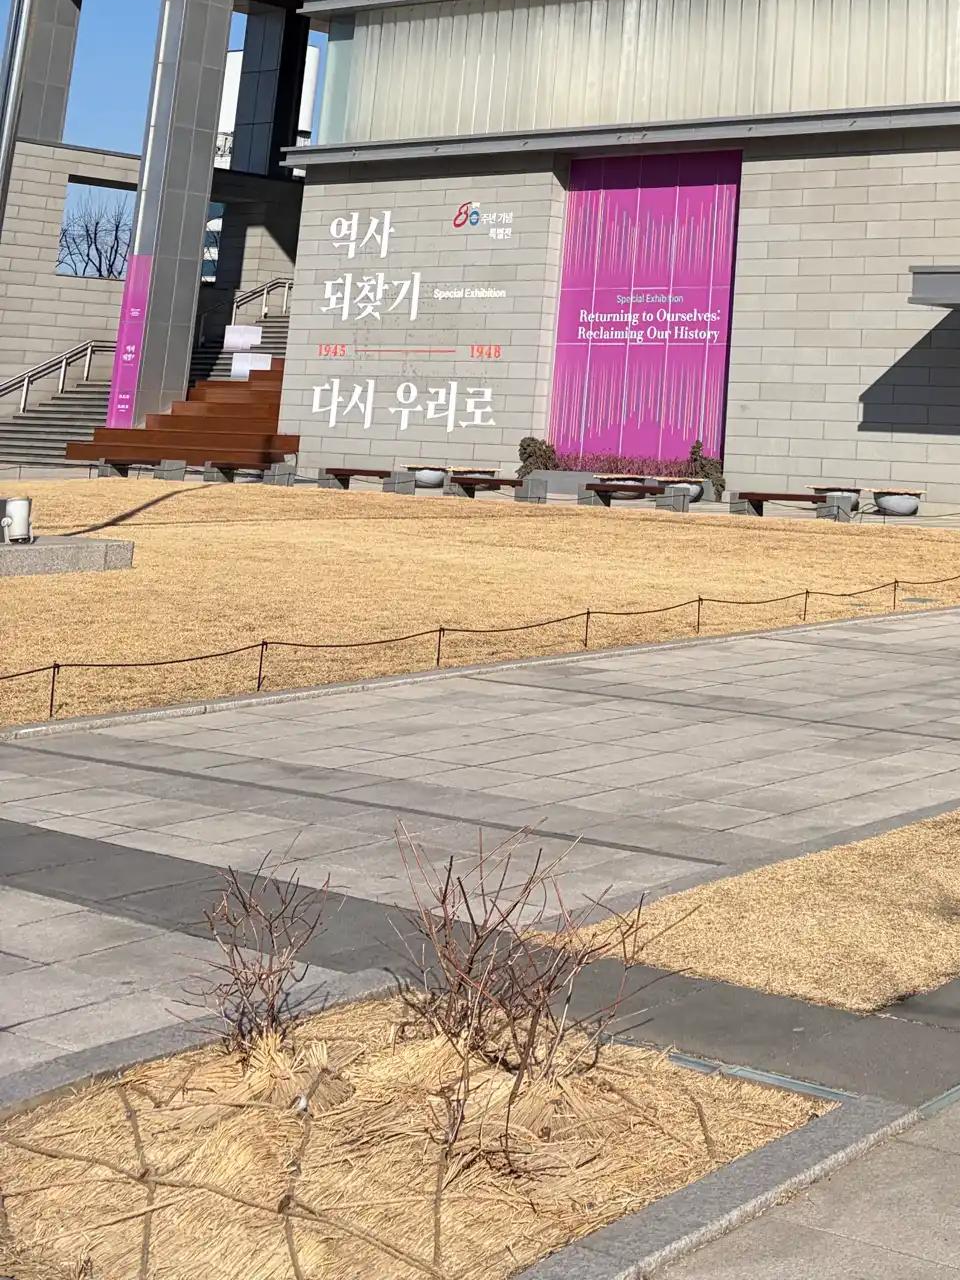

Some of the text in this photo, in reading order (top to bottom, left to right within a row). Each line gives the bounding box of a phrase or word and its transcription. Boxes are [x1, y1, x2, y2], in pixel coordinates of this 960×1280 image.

[330, 210, 396, 259] 역사
[320, 271, 422, 321] 되찾기
[432, 287, 507, 300] Special Exhibition
[616, 293, 684, 305] Special Exhibition
[579, 308, 721, 326] Returning to Ourselves:
[577, 325, 720, 343] Reclaiming Our History
[316, 344, 502, 359] 1945 1948
[312, 378, 496, 432] 다시 우리로
